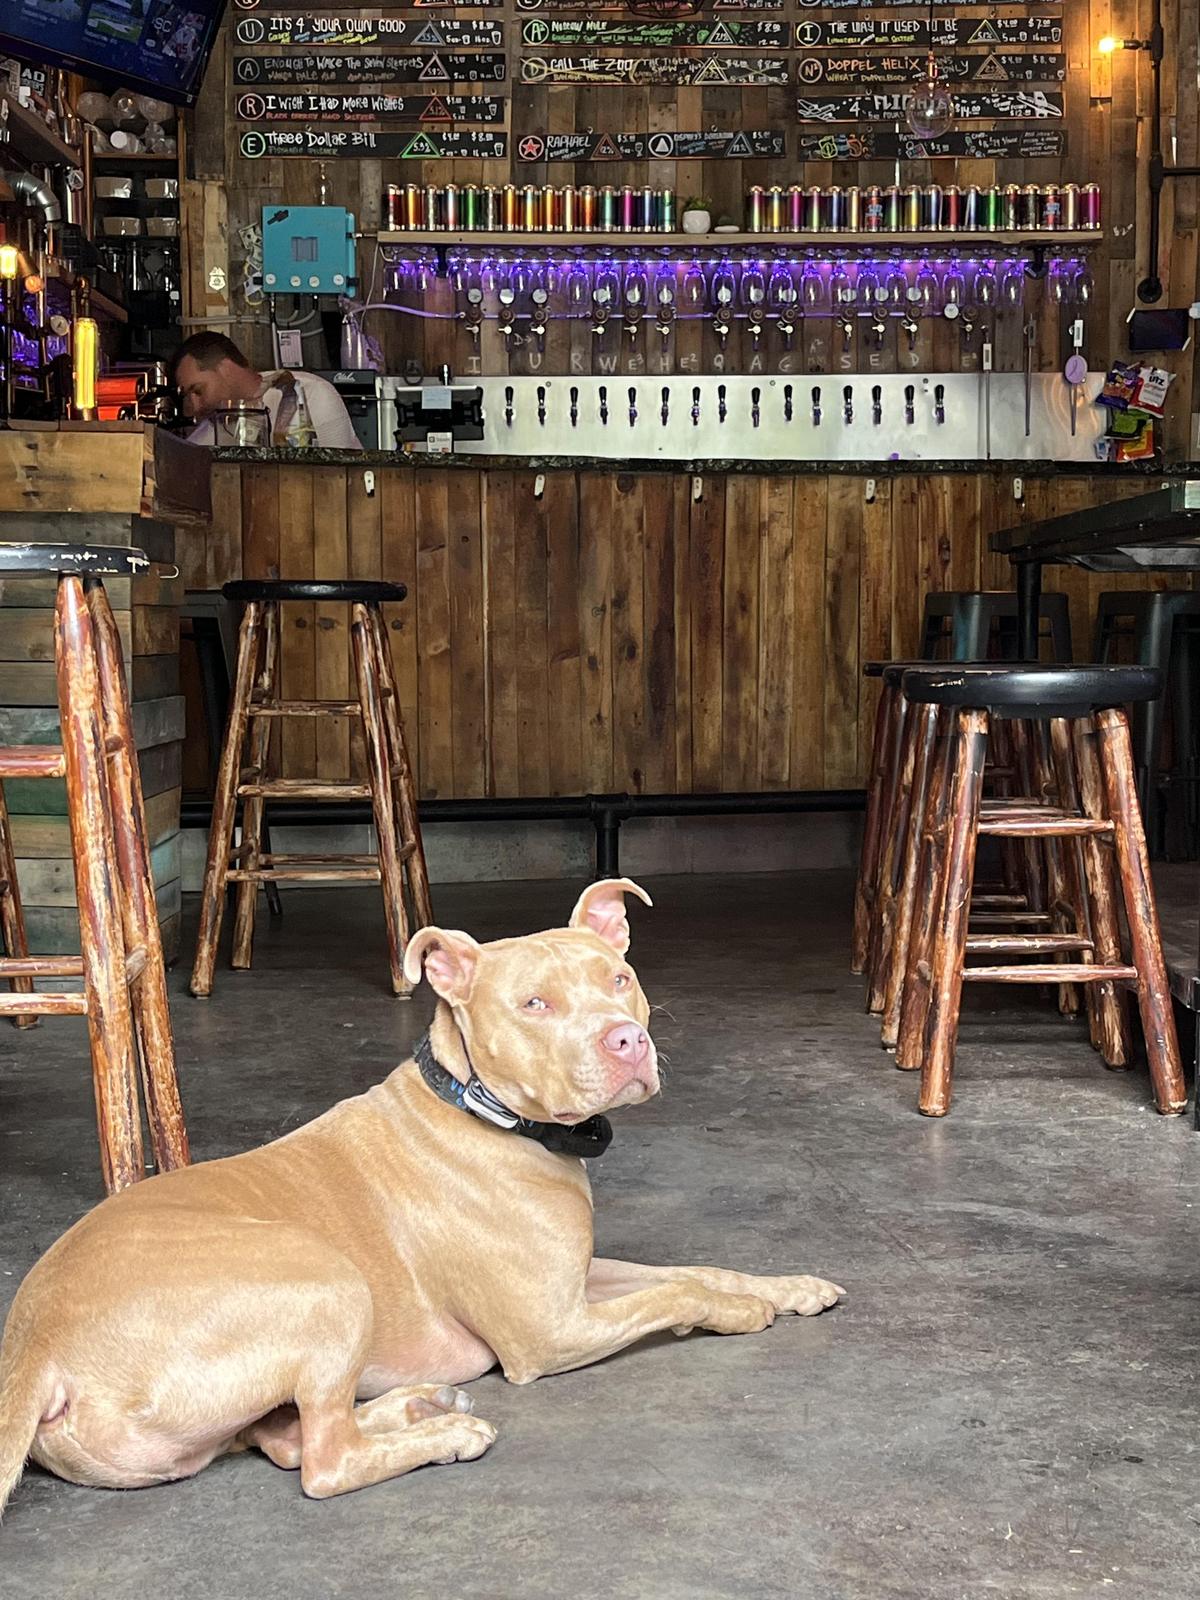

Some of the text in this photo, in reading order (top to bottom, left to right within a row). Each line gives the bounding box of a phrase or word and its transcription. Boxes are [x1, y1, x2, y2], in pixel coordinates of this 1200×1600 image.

[295, 17, 305, 33] 4
[312, 18, 342, 32] YOUR
[346, 18, 372, 33] OWN
[378, 19, 406, 33] GOOD
[828, 22, 848, 34] THE
[851, 21, 874, 33] WAY
[881, 21, 890, 33] IT
[894, 20, 921, 32] USED
[944, 19, 958, 31] BE
[997, 17, 1050, 30] $4.00 $7.00
[604, 58, 634, 71] ZOO
[827, 58, 877, 71] DOPPEL
[849, 101, 860, 117] 4
[547, 135, 591, 148] RAPHAEL
[468, 356, 481, 373] I
[529, 352, 541, 369] U
[570, 352, 583, 371] R
[599, 355, 617, 373] W
[659, 356, 670, 371] H
[750, 355, 762, 371] A
[840, 354, 851, 369] S
[869, 353, 881, 367] E
